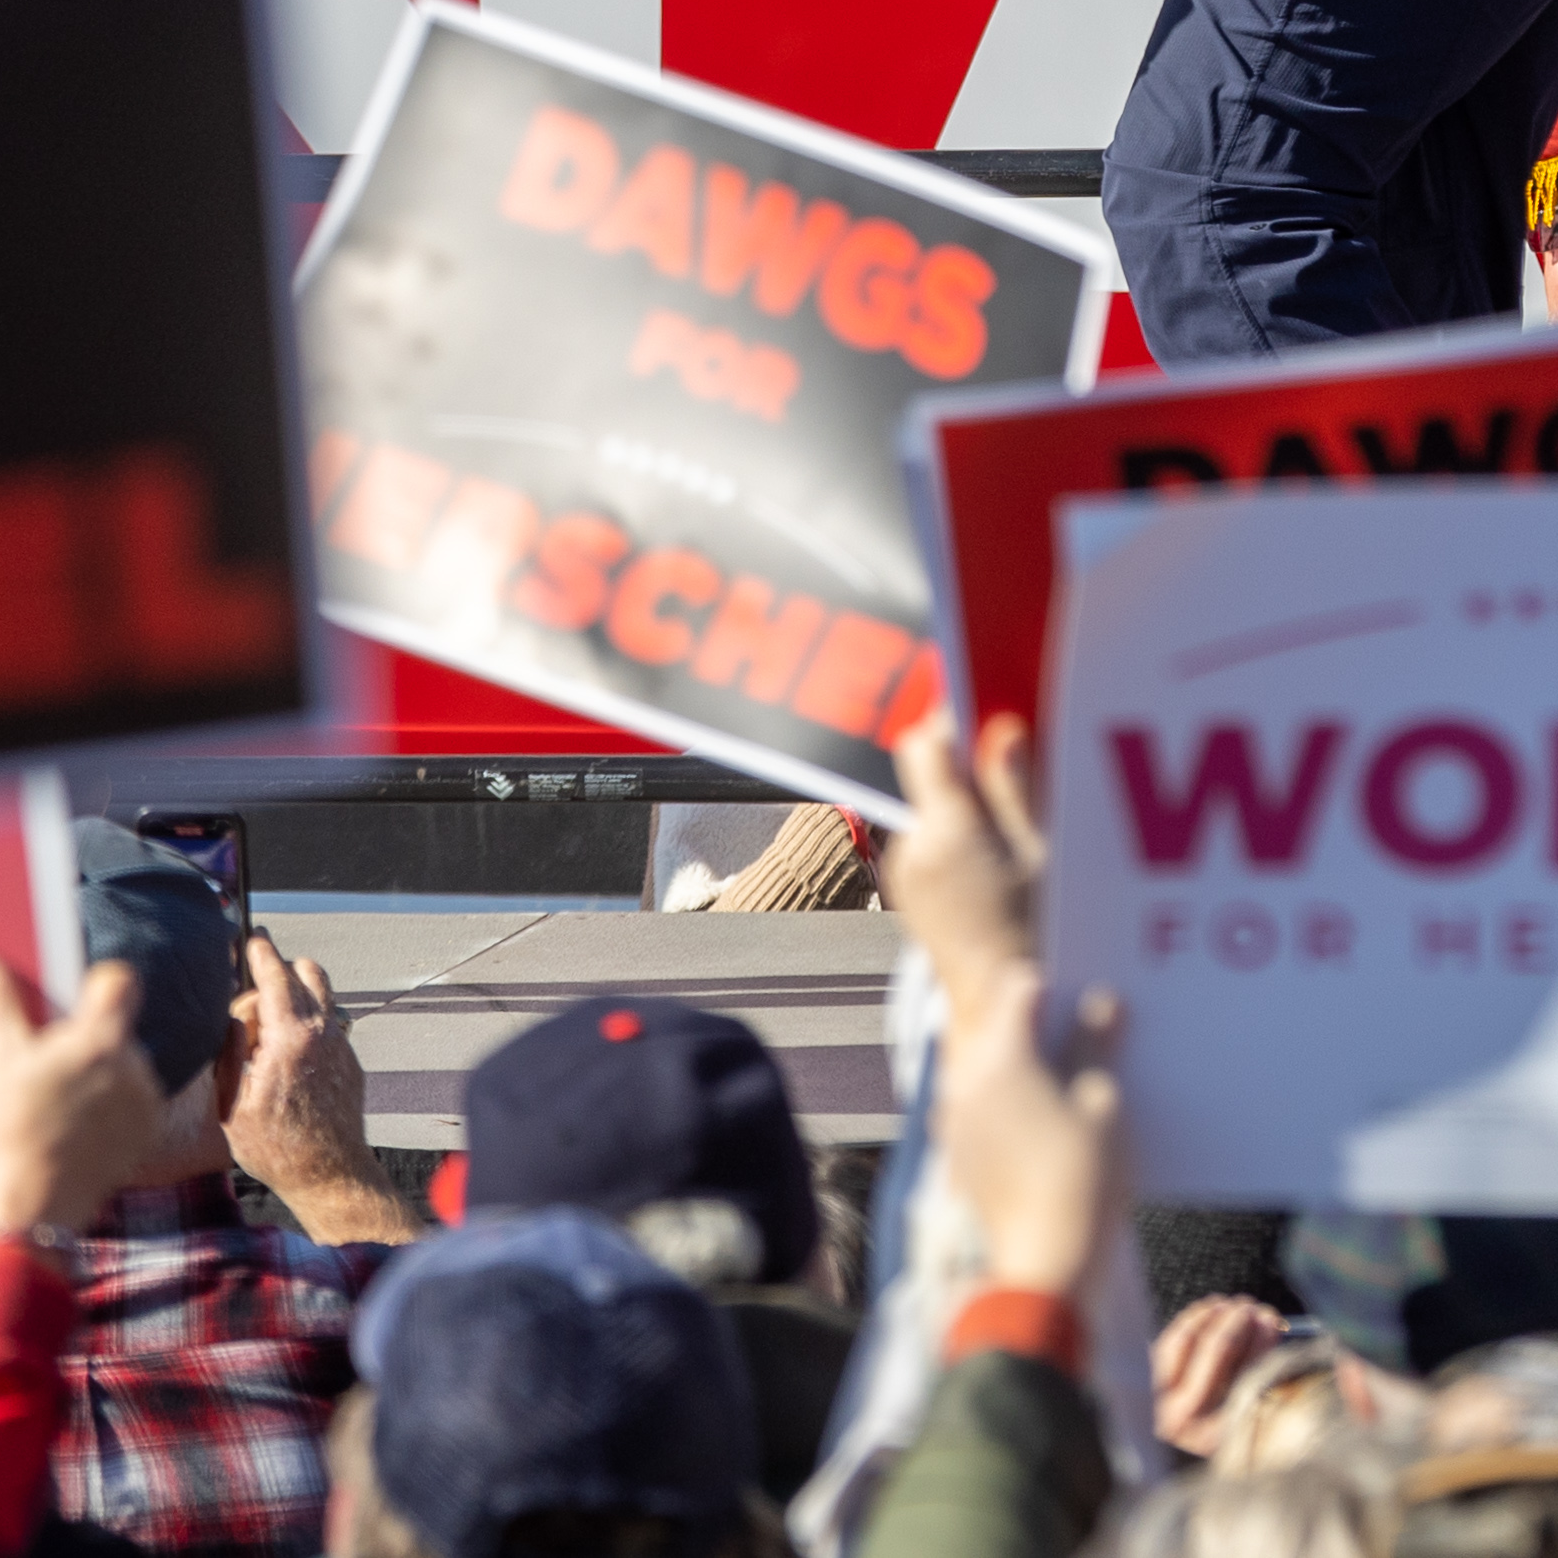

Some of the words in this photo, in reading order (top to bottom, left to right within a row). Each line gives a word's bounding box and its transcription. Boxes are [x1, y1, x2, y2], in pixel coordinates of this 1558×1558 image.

[499, 105, 999, 380] DAWGS
[629, 309, 803, 426] FOR
[1143, 901, 1355, 970] FOR
